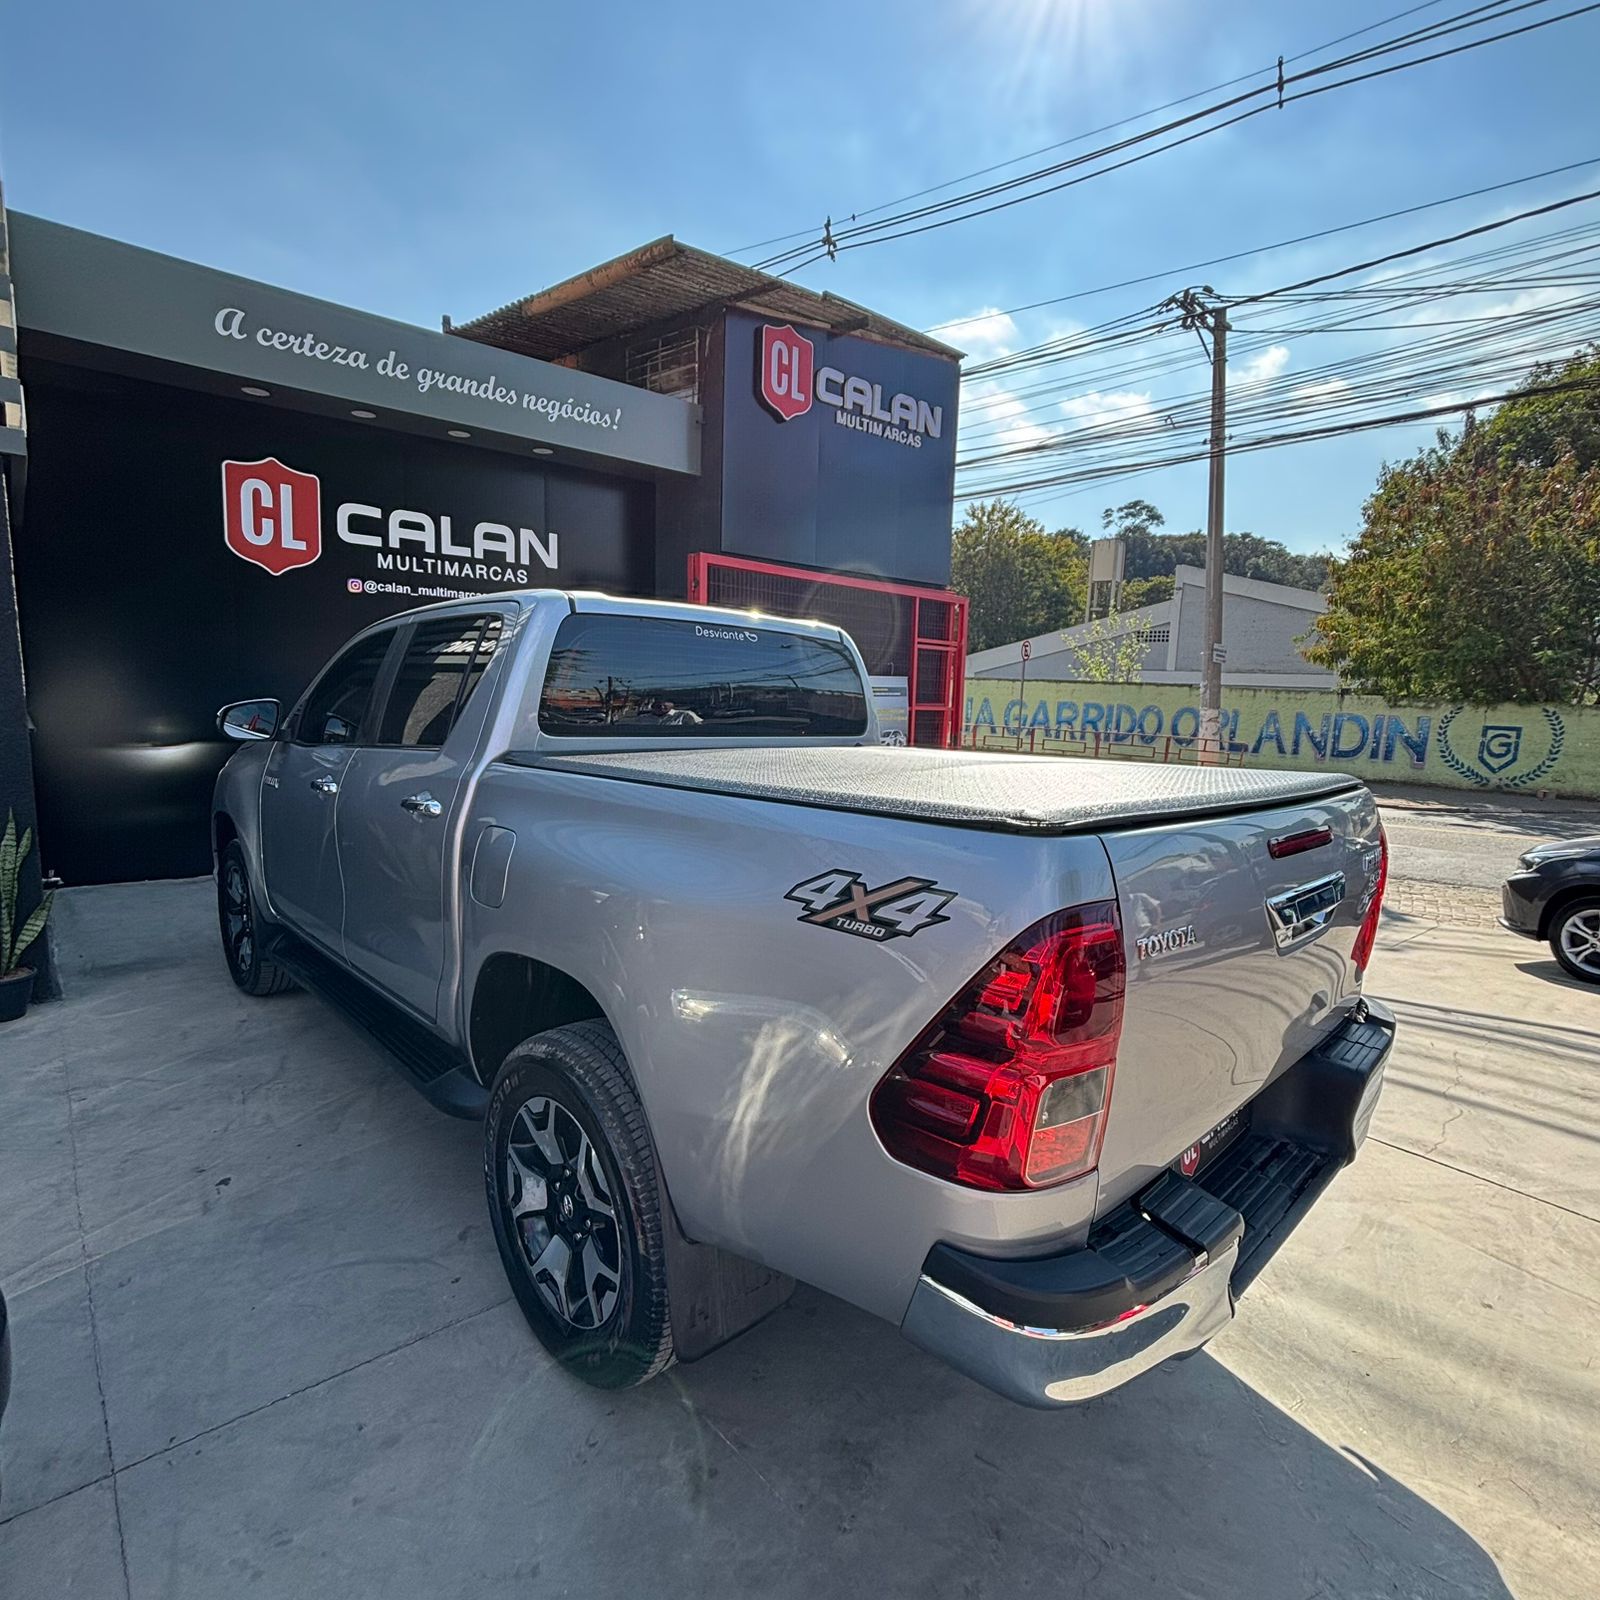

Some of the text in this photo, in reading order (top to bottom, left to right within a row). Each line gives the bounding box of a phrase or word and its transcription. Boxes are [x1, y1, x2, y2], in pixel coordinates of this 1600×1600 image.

[255, 325, 370, 369] certeza
[376, 350, 410, 381] de
[416, 368, 518, 405] grandes
[522, 393, 622, 430] negócios!
[771, 340, 805, 402] CL
[816, 367, 943, 439] CALAN
[836, 410, 924, 449] MULTIMARCAS
[240, 478, 307, 551] CL
[336, 502, 558, 569] CALAN
[376, 553, 529, 584] MULTIMARCAS
[695, 625, 745, 641] Desviante
[1003, 699, 1164, 744] GARRIDO
[1486, 733, 1512, 759] G
[836, 917, 886, 937] TURBO
[1136, 925, 1197, 960] TOYOTA
